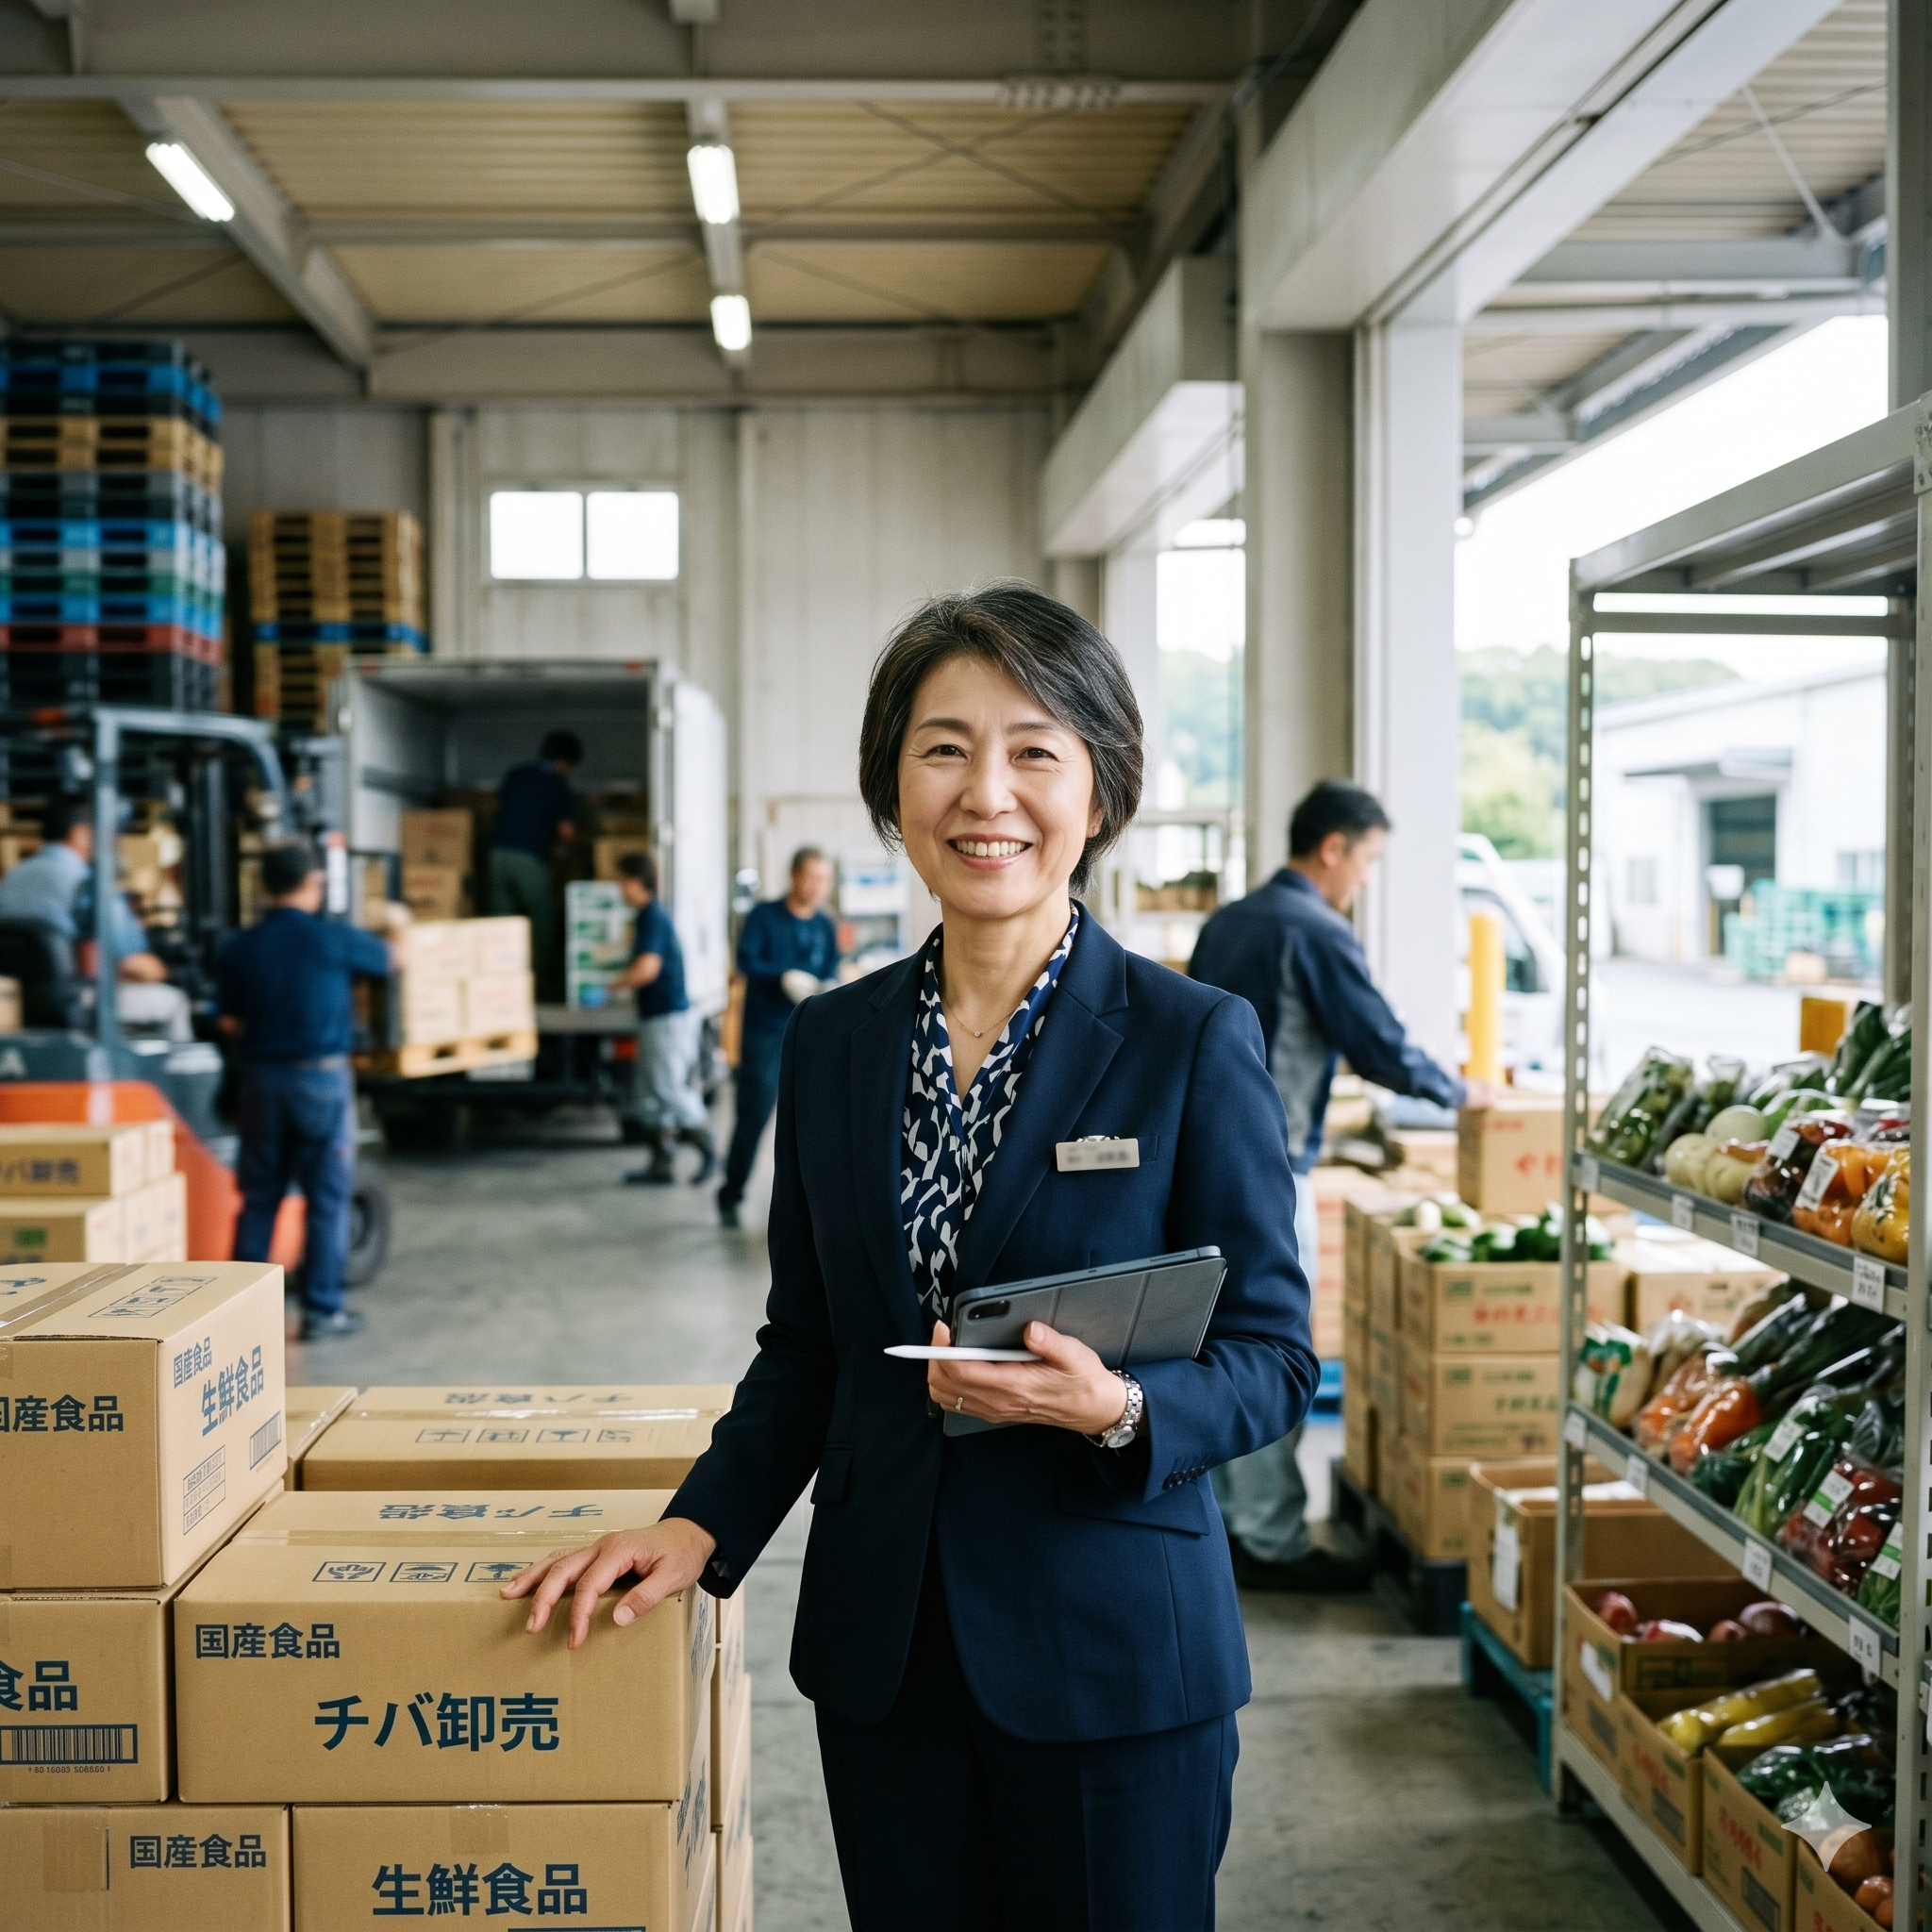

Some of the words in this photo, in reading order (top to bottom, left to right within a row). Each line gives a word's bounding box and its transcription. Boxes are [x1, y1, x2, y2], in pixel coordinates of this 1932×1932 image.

[174, 1336, 212, 1390] 国産食品
[0, 1394, 124, 1433] 産食品
[201, 1344, 264, 1437] 生鮮食品
[195, 1622, 341, 1659] 国産食品
[314, 1692, 560, 1753] チバ卸売
[129, 1834, 267, 1869] 国産食品
[372, 1862, 588, 1917] 生鮮食品
